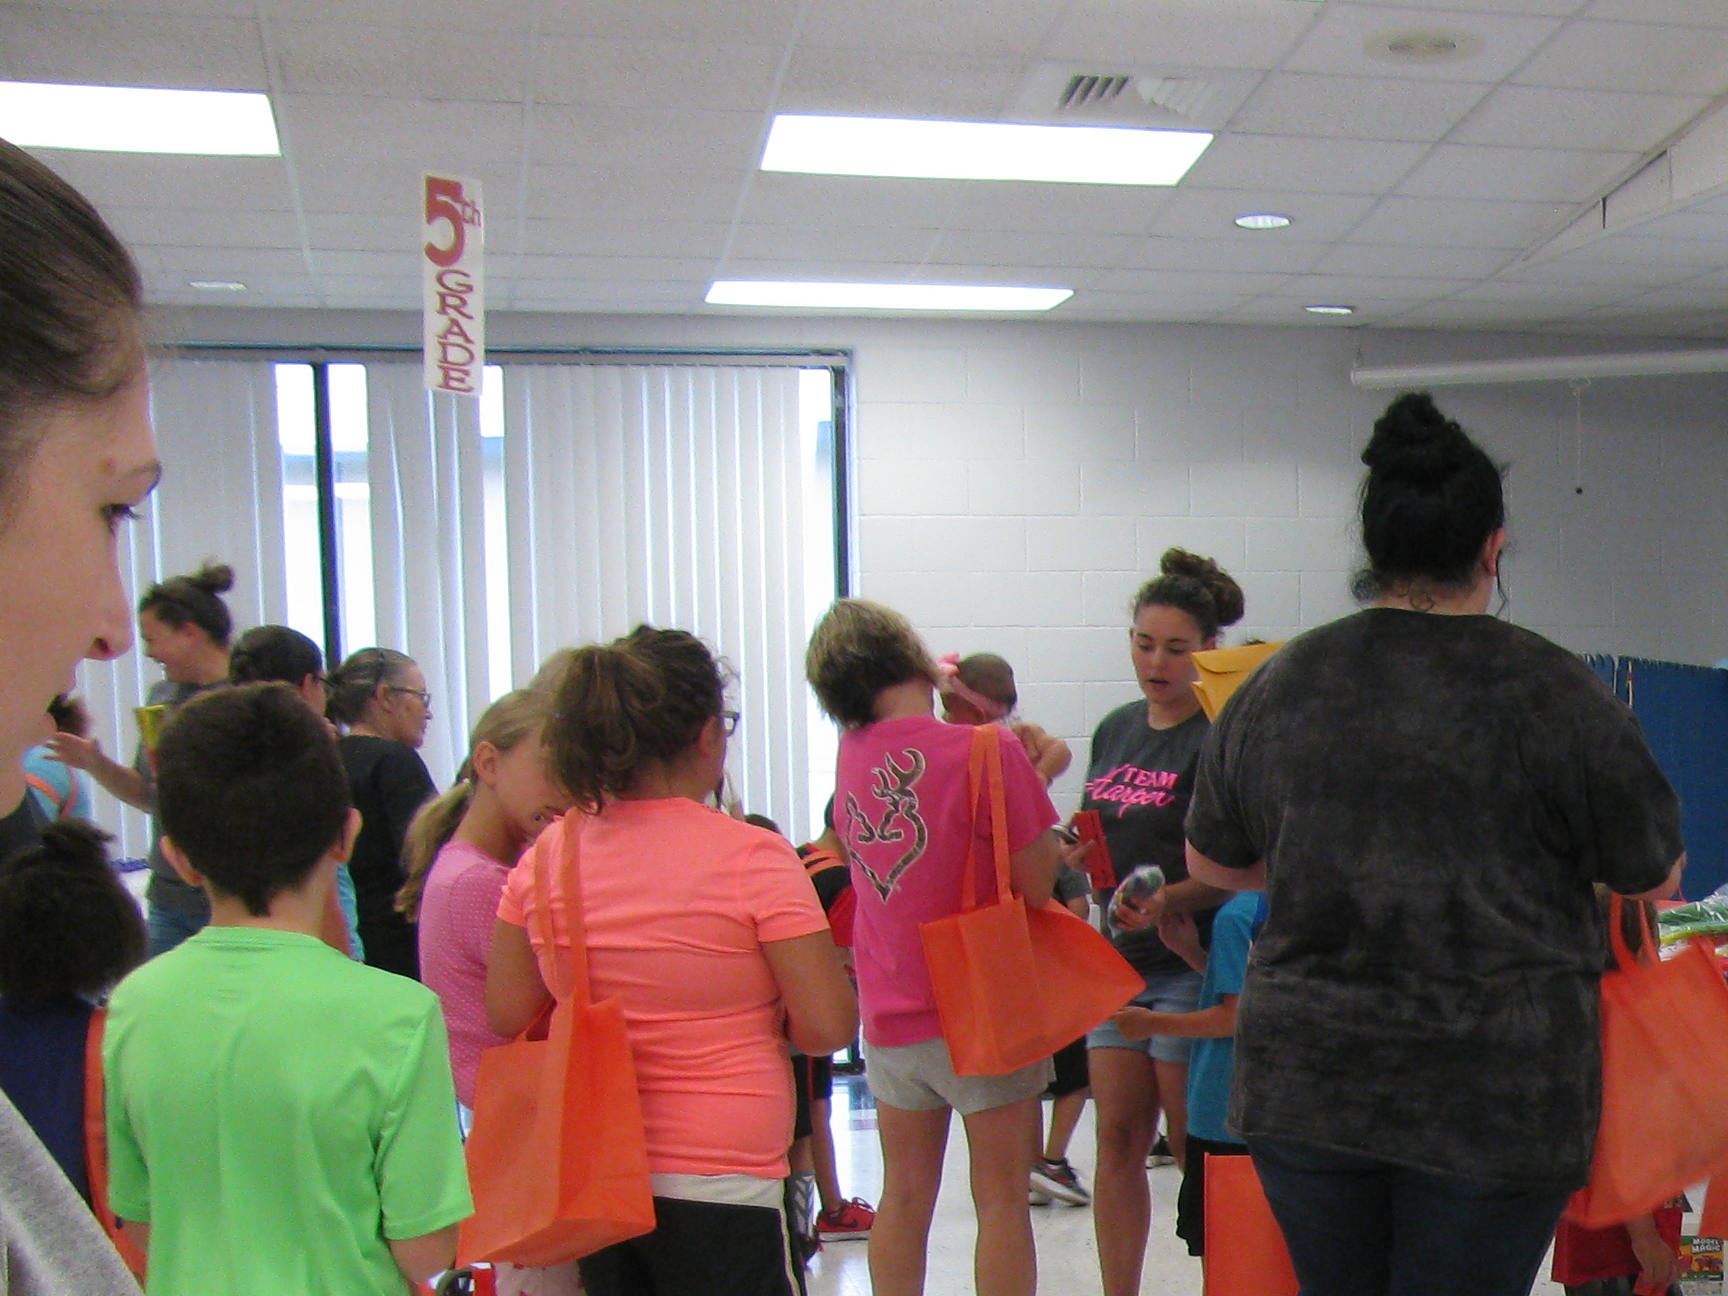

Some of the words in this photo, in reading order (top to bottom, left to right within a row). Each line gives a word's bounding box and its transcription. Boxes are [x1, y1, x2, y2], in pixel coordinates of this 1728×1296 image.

[424, 175, 482, 268] 5th
[435, 269, 475, 393] GRADE
[1123, 767, 1179, 790] TEAM
